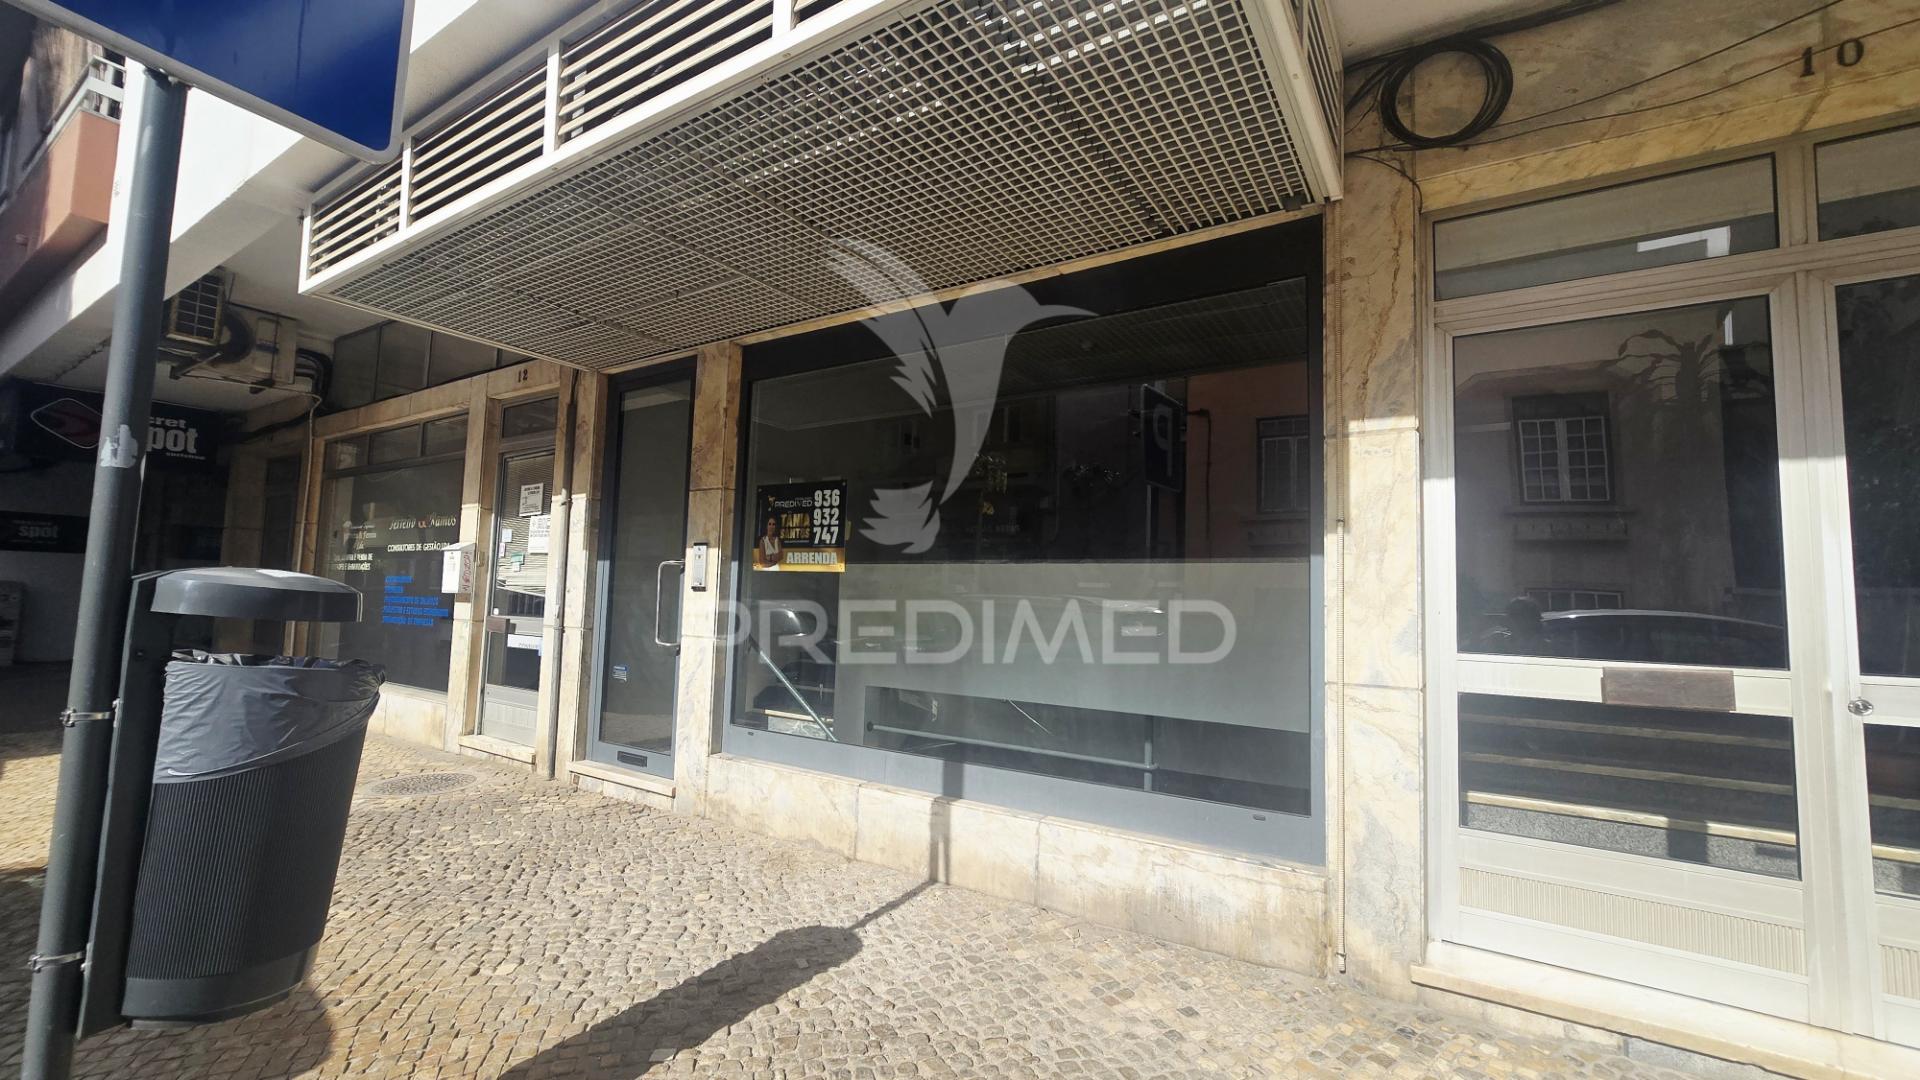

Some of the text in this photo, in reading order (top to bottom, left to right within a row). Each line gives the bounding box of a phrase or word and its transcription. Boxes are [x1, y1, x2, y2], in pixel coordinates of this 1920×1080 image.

[1800, 38, 1864, 78] 10
[518, 369, 528, 383] 12
[814, 489, 841, 507] 936
[813, 508, 840, 526] 932
[780, 527, 811, 540] SANTOS
[813, 526, 839, 545] 747
[786, 551, 838, 565] ARRENDA
